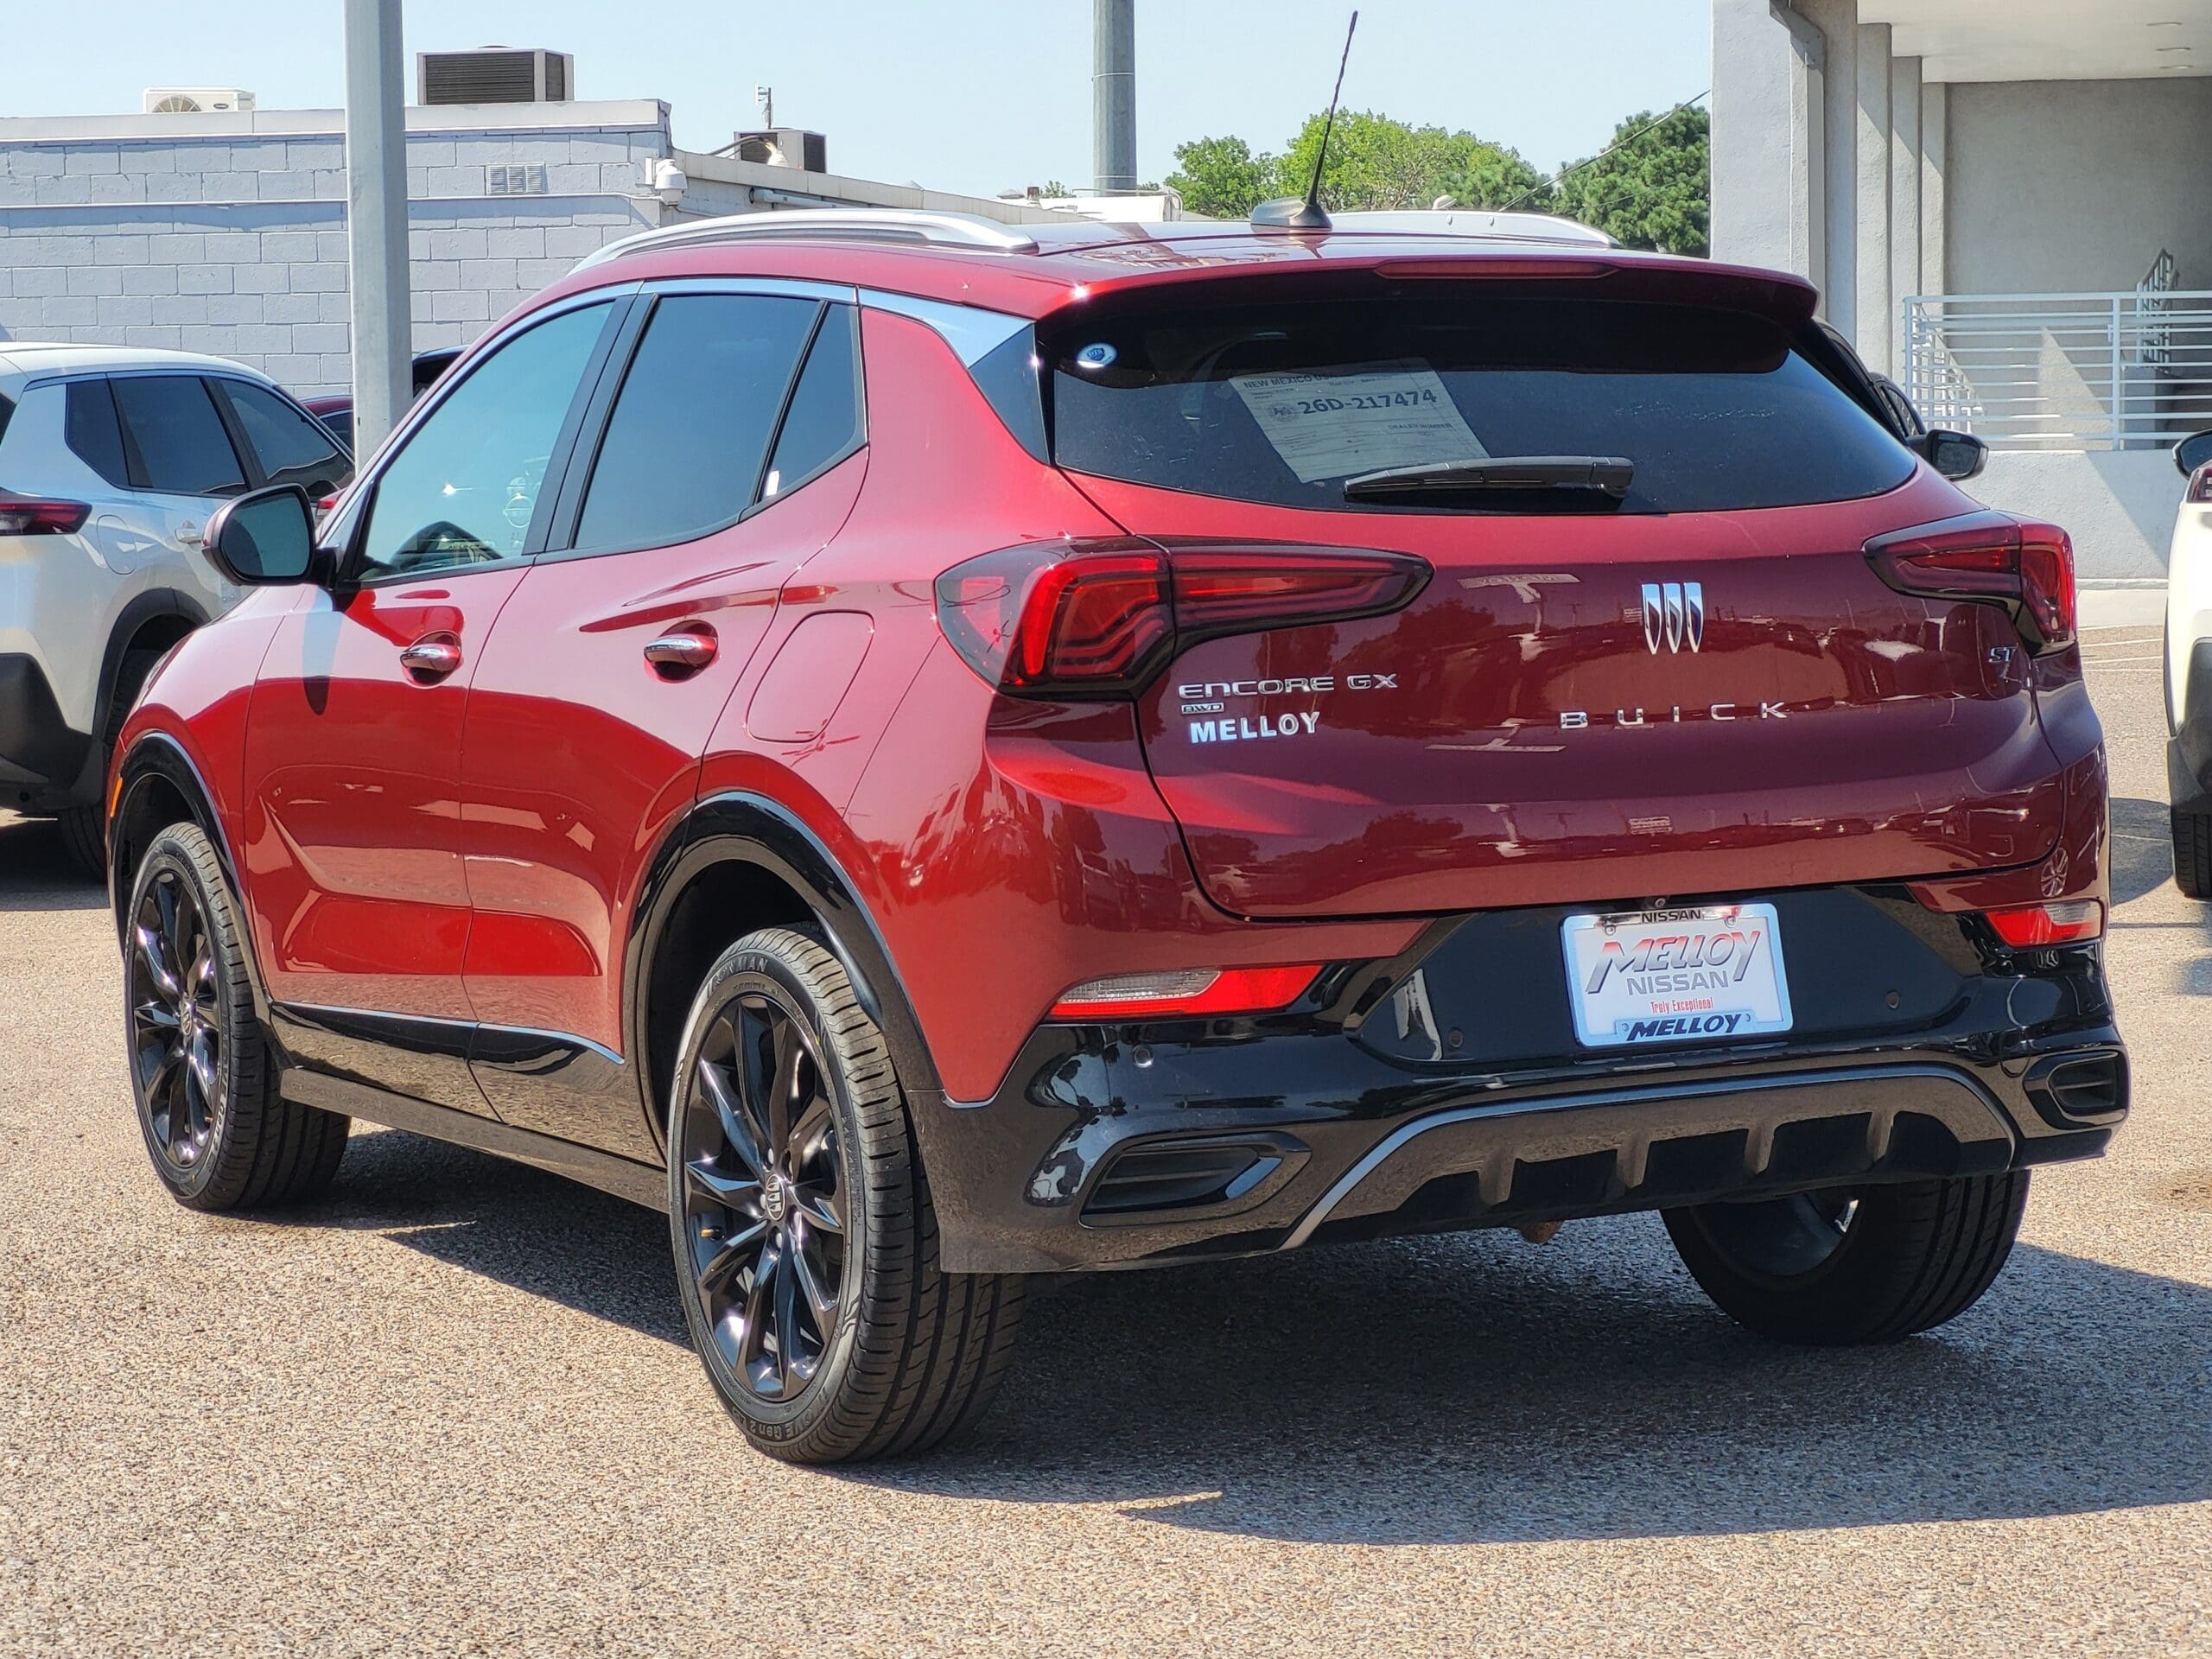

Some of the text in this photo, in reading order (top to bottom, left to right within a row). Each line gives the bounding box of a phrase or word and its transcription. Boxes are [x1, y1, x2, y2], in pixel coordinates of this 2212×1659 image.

[1244, 379, 1268, 389] NEW
[1272, 375, 1312, 385] MEXICO
[1298, 389, 1438, 414] 26D-217474
[1179, 673, 1398, 699] ENCORE GX
[1183, 703, 1223, 713] AWD
[1560, 701, 1786, 728] BUICK
[1190, 711, 1320, 743] MELLOY
[1641, 909, 1702, 924] NISSAN
[1585, 931, 1761, 995] MELLOY
[1627, 970, 1728, 995] NISSAN
[1650, 996, 1714, 1014] Truly Exceptional
[1626, 1014, 1742, 1041] MELLOY
